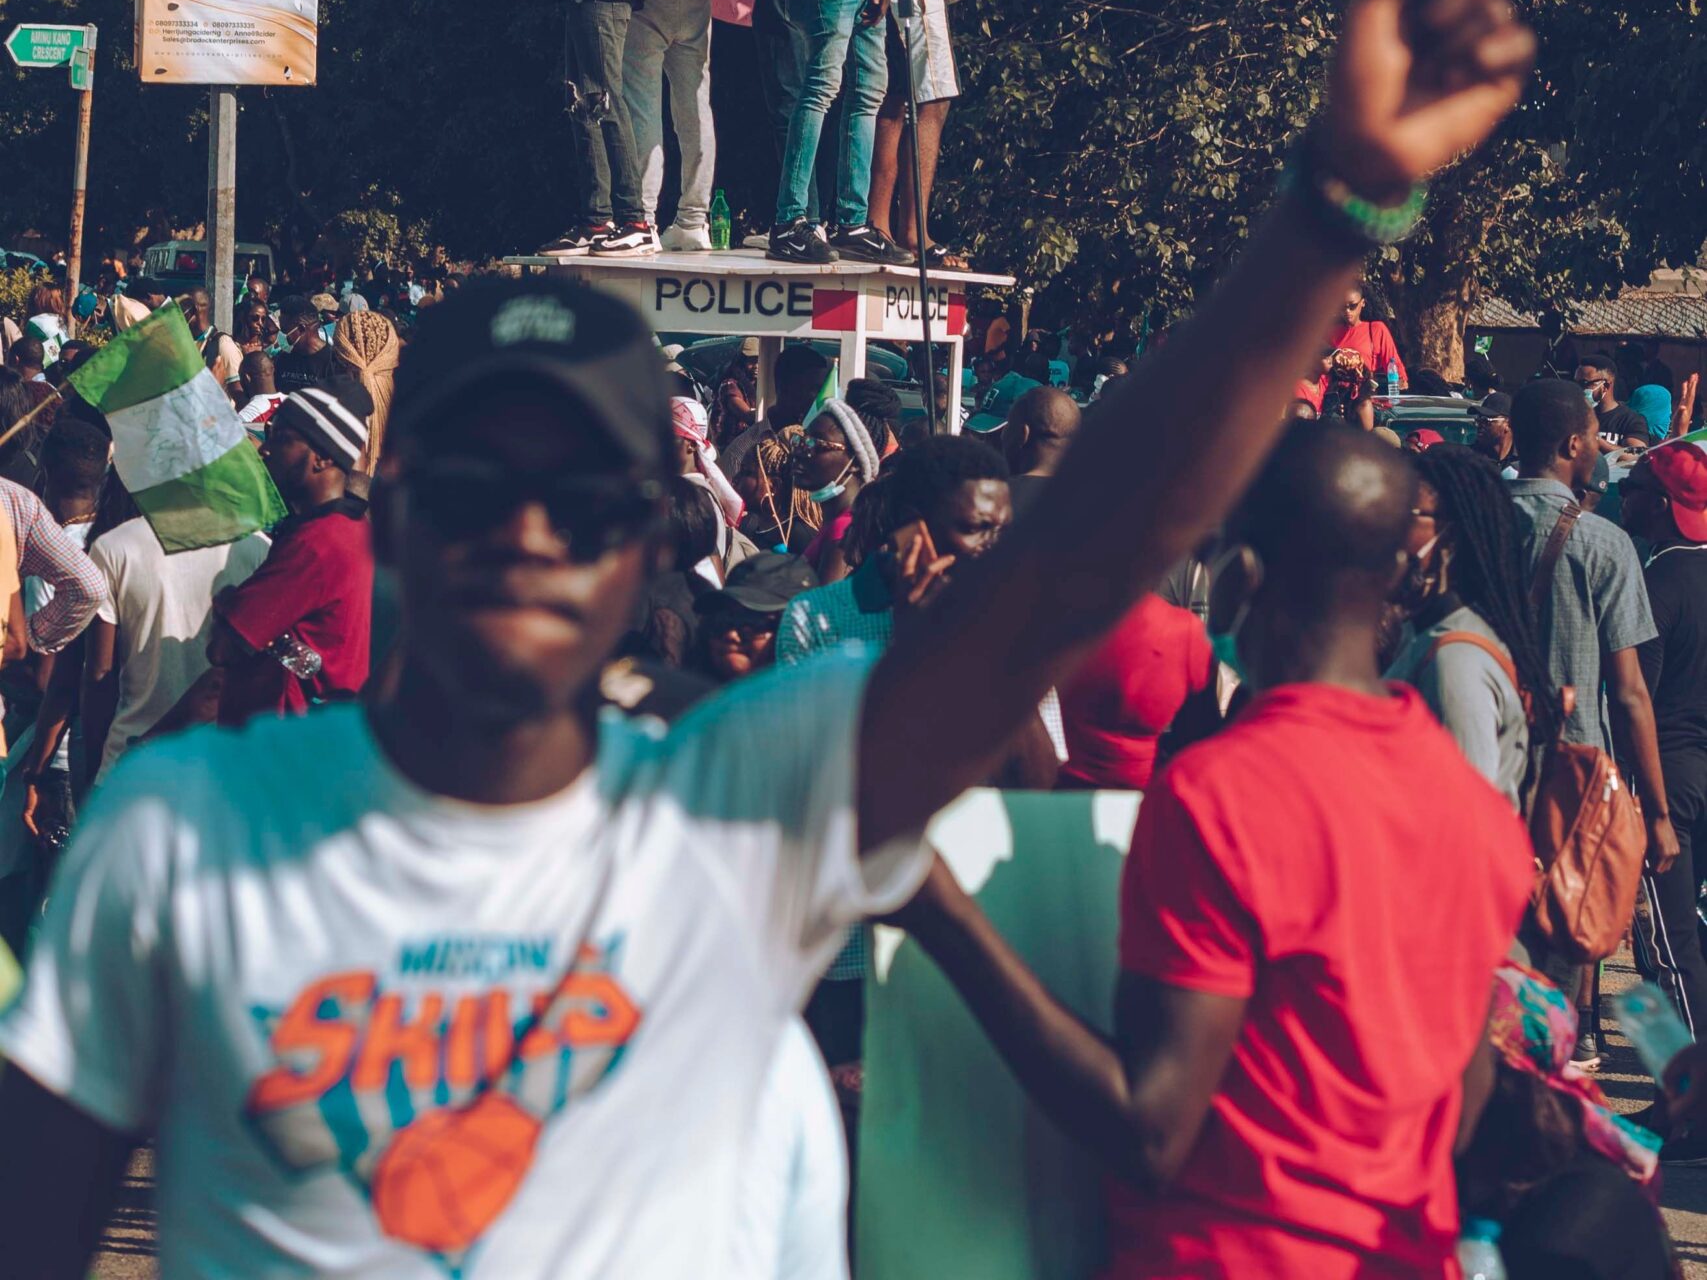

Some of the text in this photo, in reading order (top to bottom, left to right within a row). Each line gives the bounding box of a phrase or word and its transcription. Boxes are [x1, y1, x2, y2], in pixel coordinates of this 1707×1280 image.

[32, 45, 66, 61] CRESCENT
[655, 277, 814, 317] POLICE
[886, 285, 949, 321] POLCE
